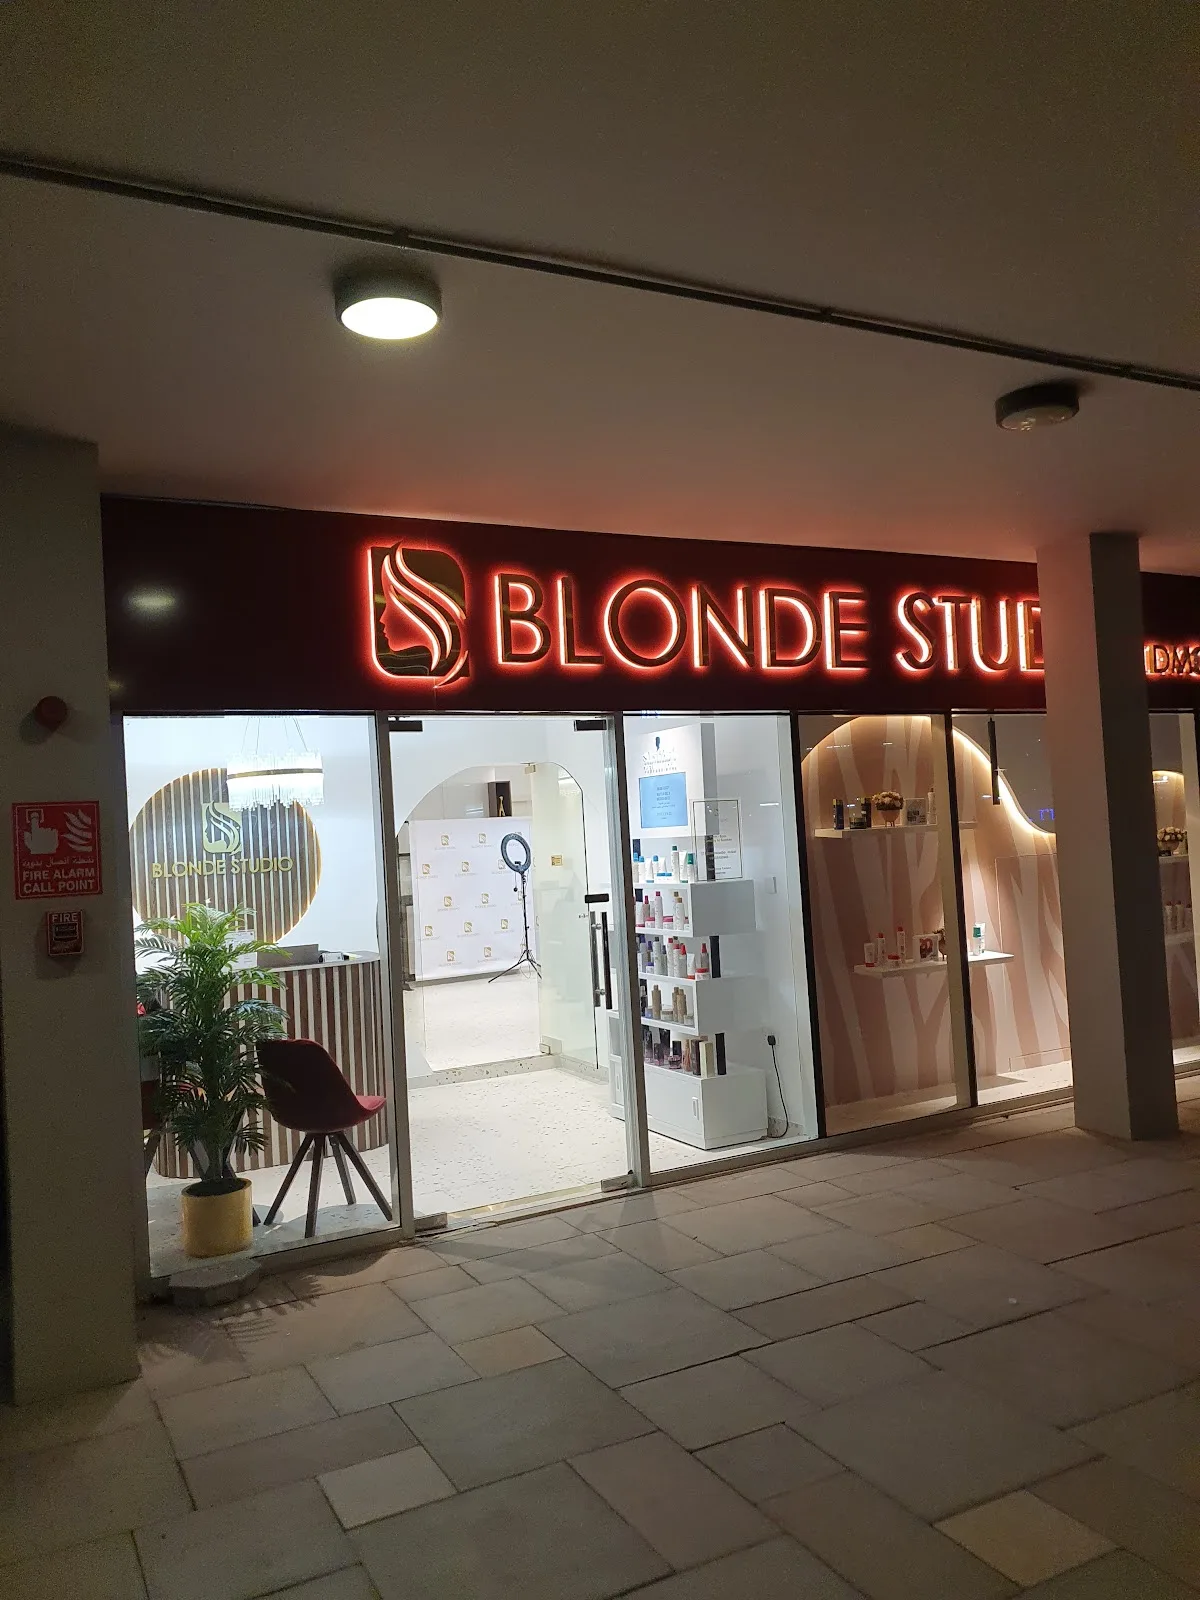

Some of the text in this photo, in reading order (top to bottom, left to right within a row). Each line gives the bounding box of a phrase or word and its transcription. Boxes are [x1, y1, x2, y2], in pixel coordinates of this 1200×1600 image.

[493, 573, 871, 671] BLONDE
[22, 868, 95, 881] FIRE ALARM
[152, 856, 293, 878] BLONDE STUDIO
[23, 879, 95, 894] CALL POINT
[51, 912, 78, 923] FIRE
